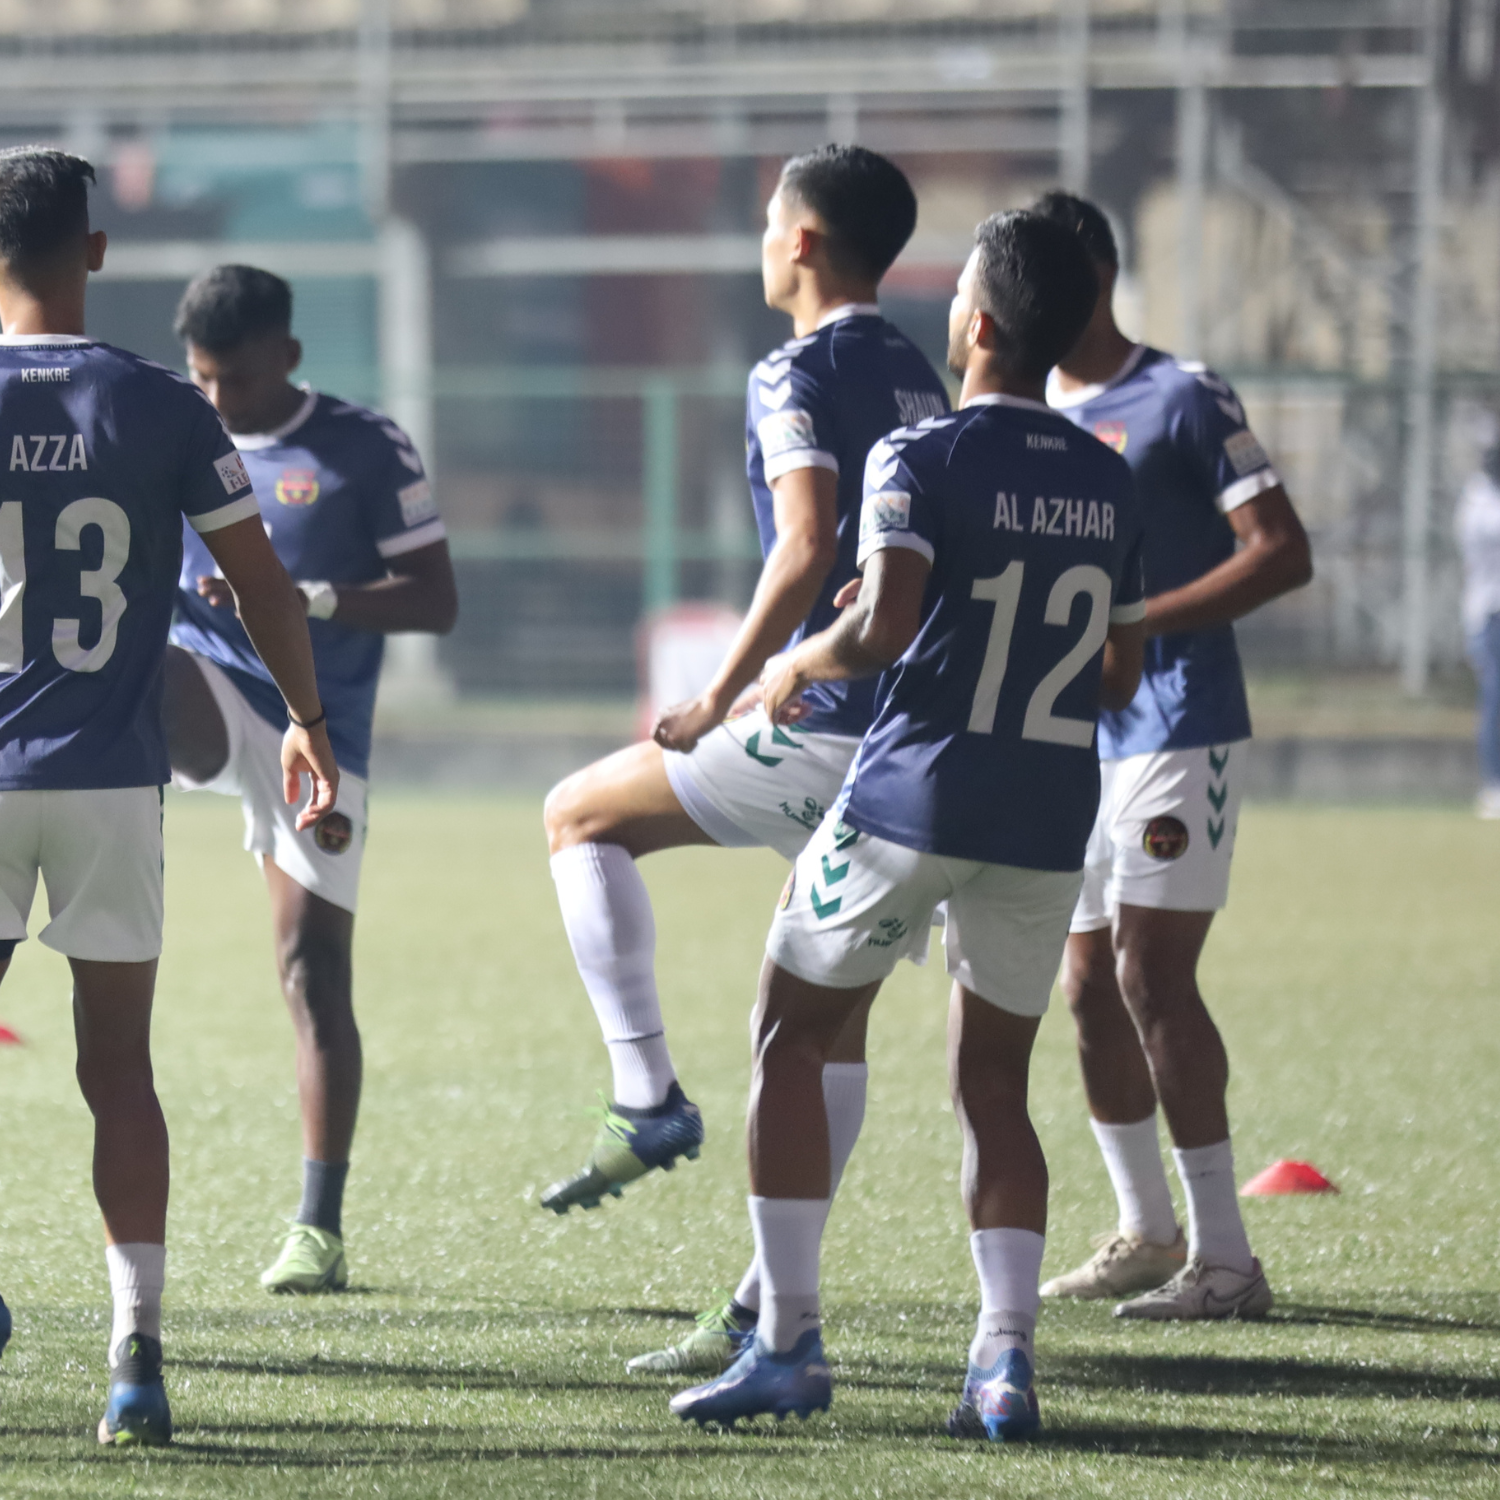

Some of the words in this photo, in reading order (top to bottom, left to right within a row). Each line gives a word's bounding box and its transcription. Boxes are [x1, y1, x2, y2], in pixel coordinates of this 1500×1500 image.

[21, 367, 71, 383] KENKRE
[9, 433, 88, 472] AZZA
[993, 492, 1024, 533] AL
[1030, 497, 1116, 542] AZHAR
[966, 559, 1113, 749] 12
